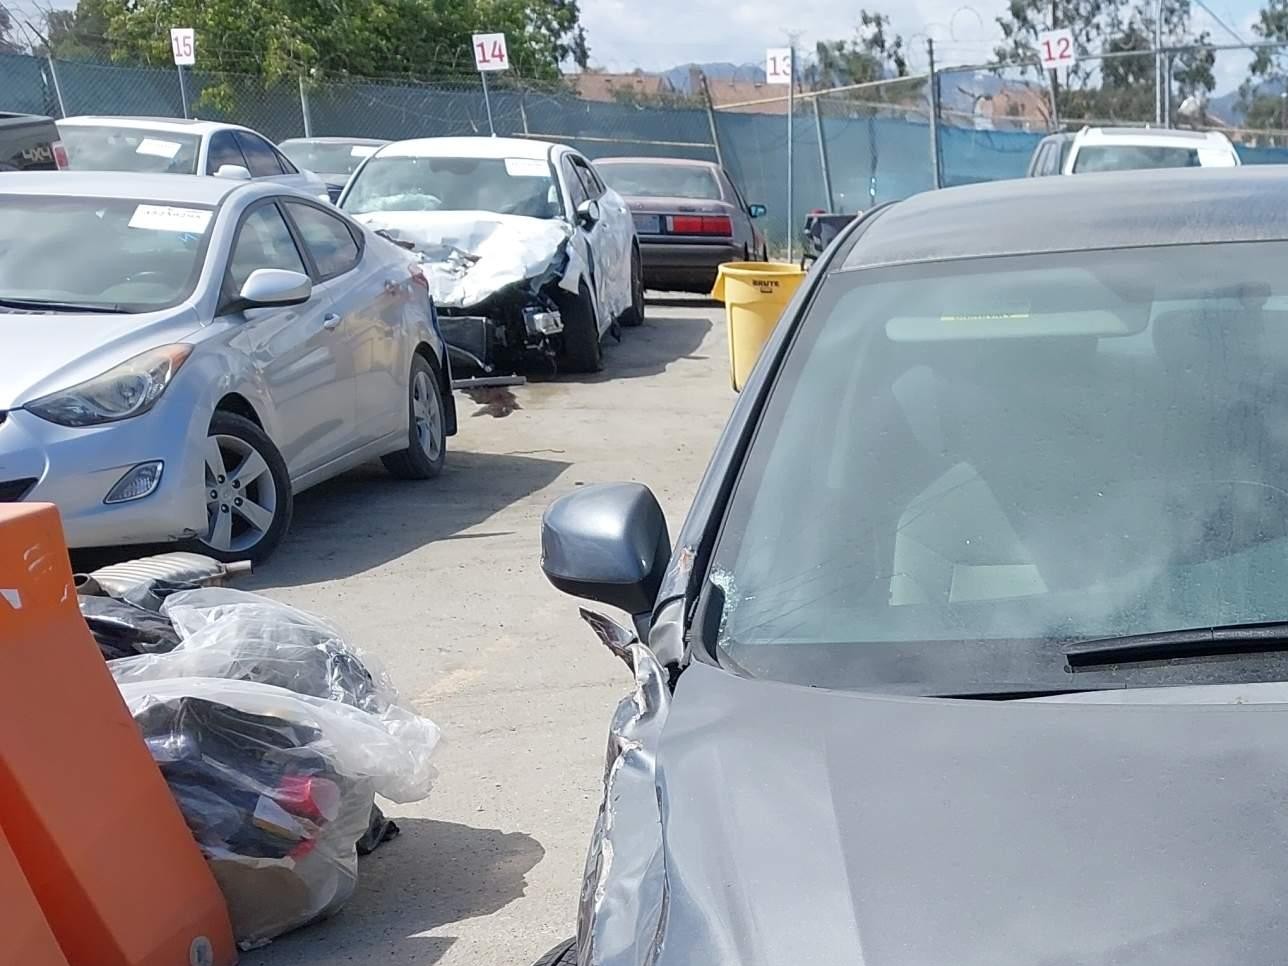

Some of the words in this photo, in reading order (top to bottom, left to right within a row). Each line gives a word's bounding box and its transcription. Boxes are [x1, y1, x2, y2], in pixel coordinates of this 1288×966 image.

[173, 35, 192, 57] 15
[476, 40, 505, 63] 14
[1042, 37, 1071, 61] 12
